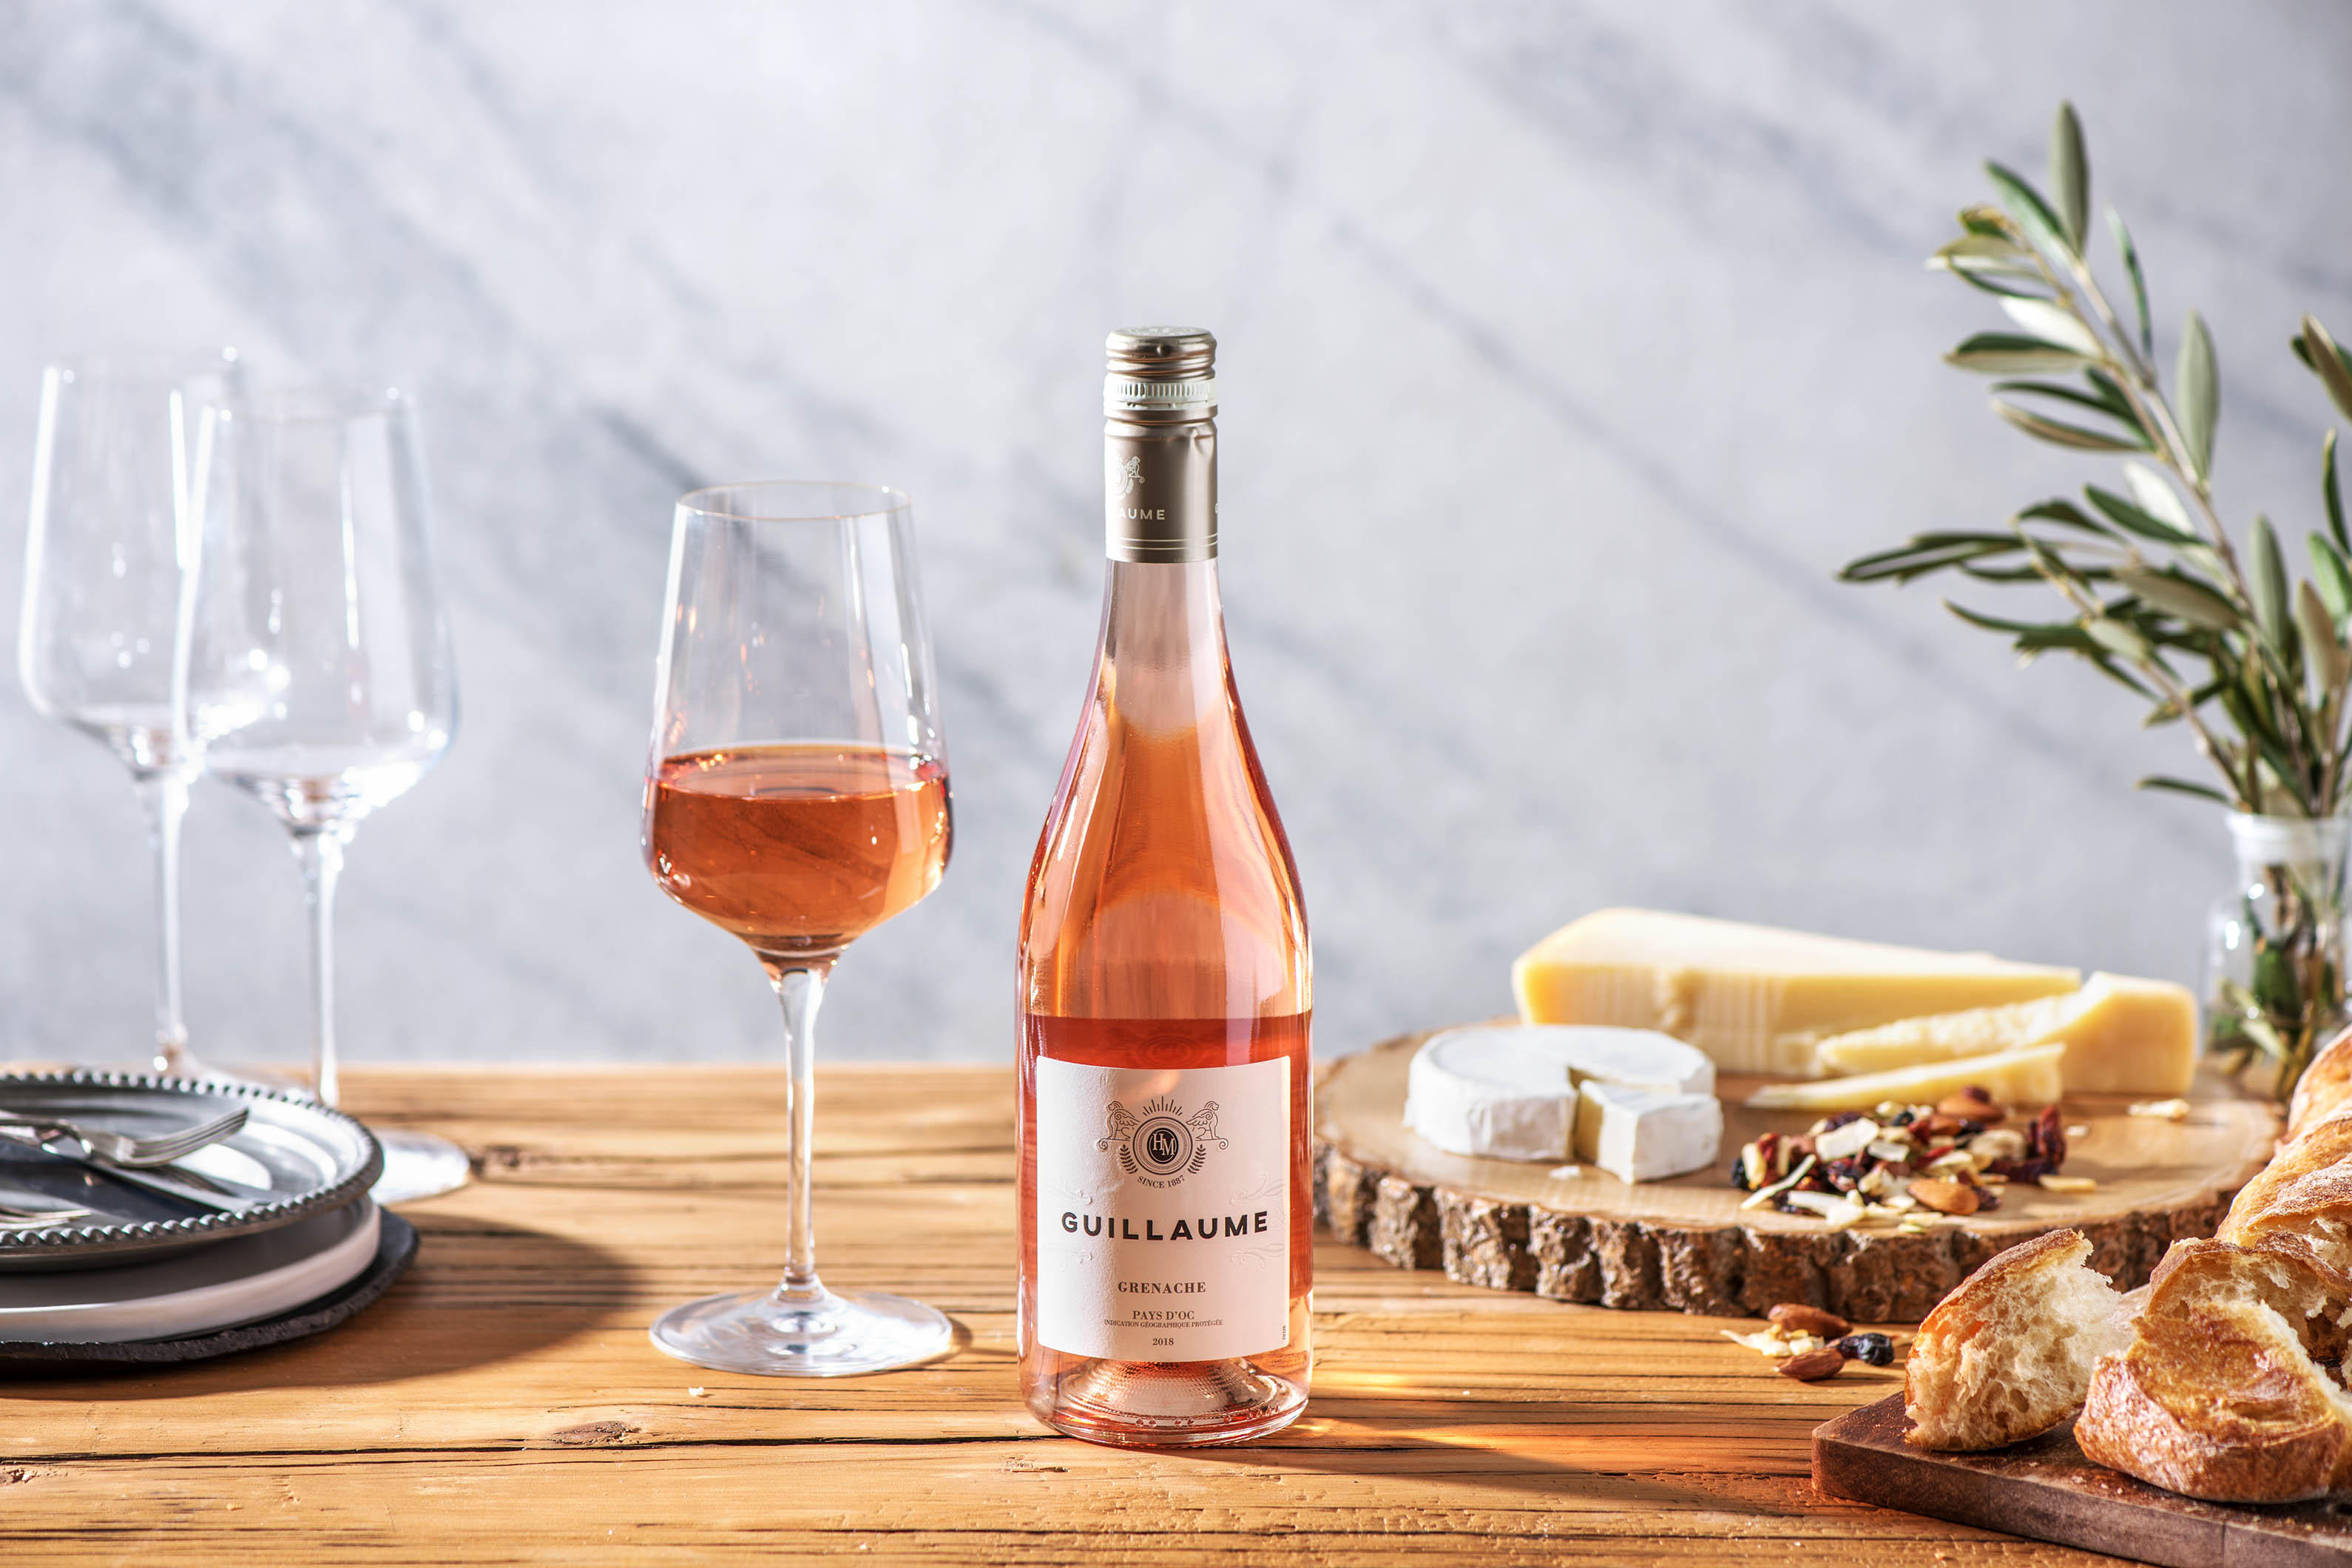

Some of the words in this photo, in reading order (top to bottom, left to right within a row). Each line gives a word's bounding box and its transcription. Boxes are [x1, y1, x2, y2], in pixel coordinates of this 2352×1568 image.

[1137, 1175, 1165, 1189] SINCE
[1166, 1175, 1185, 1188] 1887
[1061, 1210, 1268, 1241] GUILLAUME
[1118, 1281, 1206, 1294] GRENACHE
[1132, 1311, 1162, 1320] PAYS
[1166, 1310, 1194, 1320] D'OC
[1104, 1319, 1140, 1328] INDICATION
[1140, 1320, 1190, 1329] GÉOGRAPHIQUE
[1192, 1319, 1223, 1328] PROTÉGÉE
[1152, 1337, 1175, 1346] 2018
